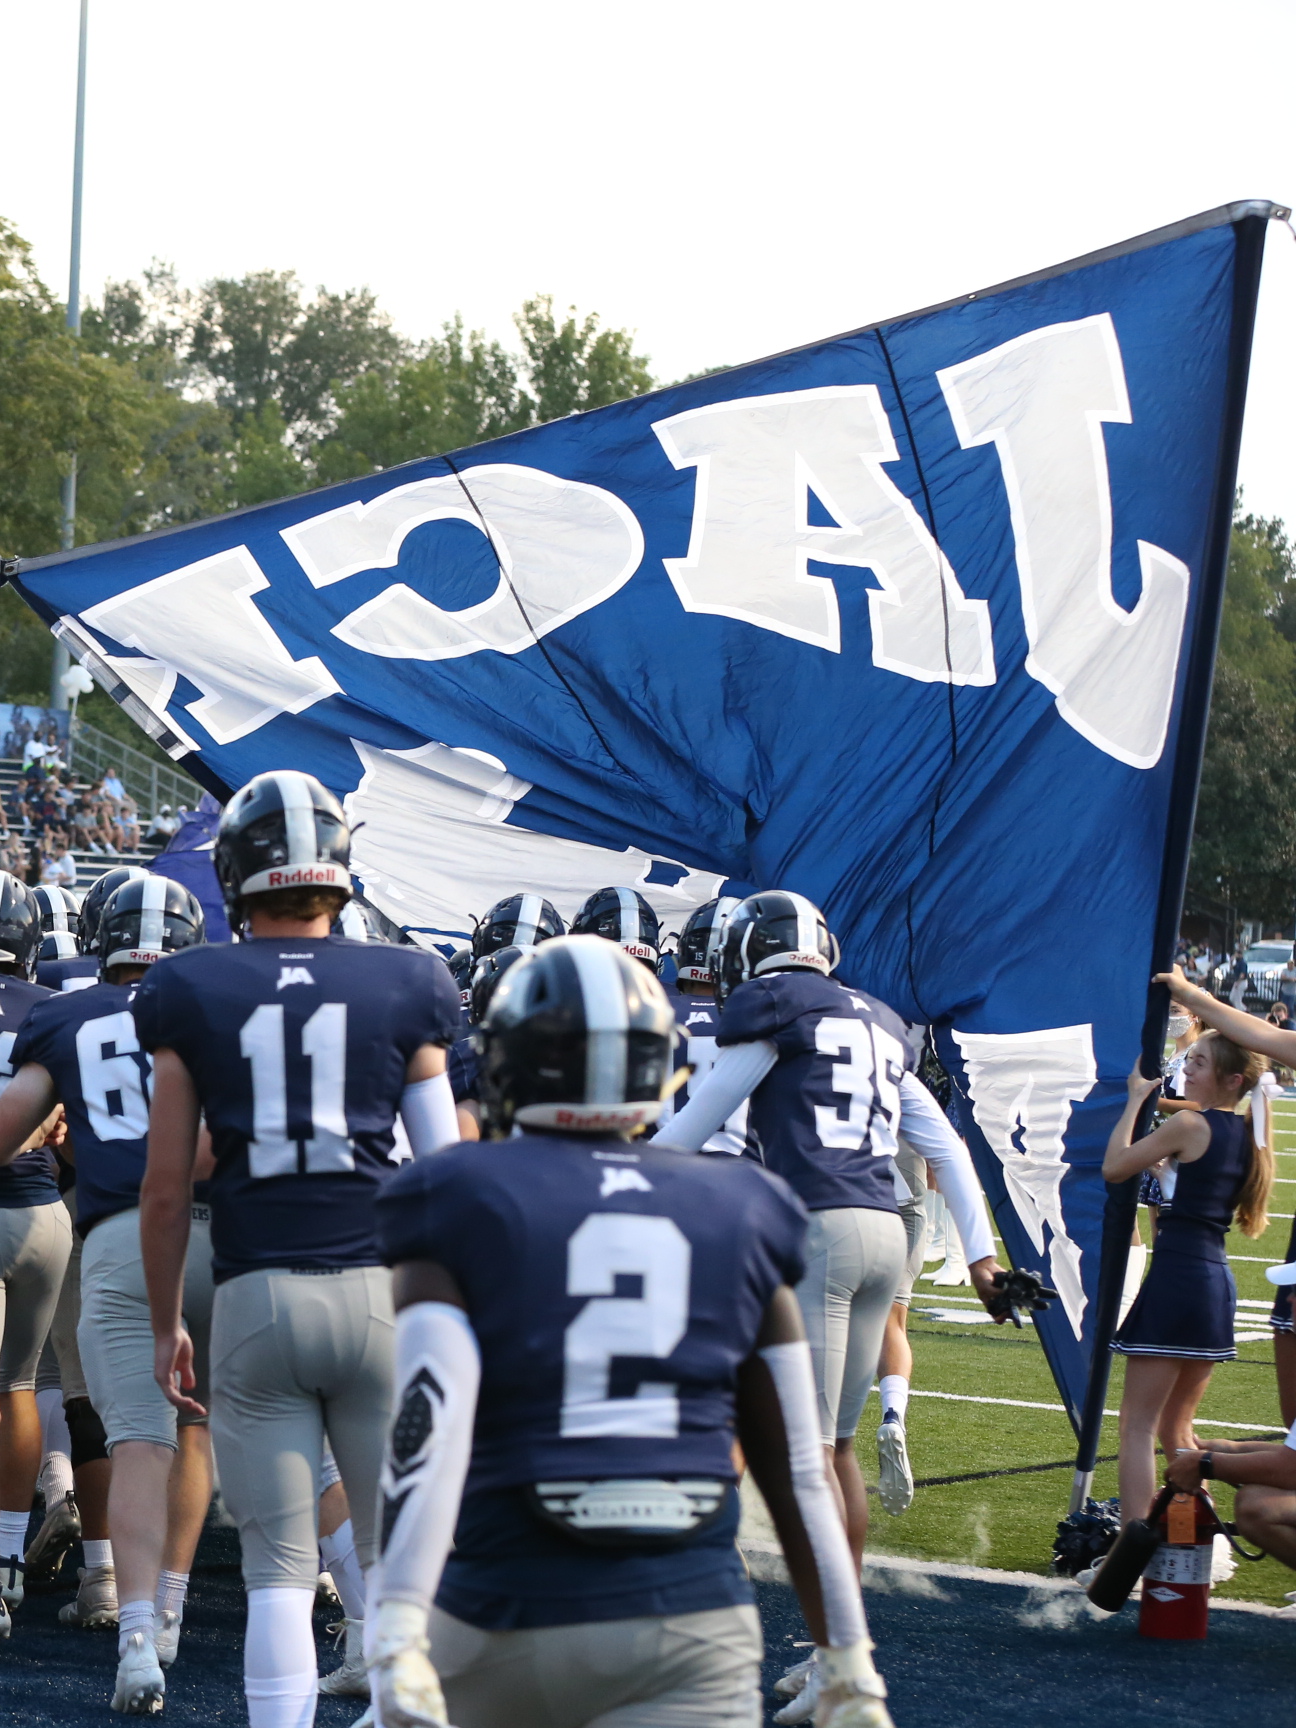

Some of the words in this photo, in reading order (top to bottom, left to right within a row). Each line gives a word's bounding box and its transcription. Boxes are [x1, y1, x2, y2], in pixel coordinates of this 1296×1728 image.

[268, 869, 336, 886] Riddell
[239, 1002, 356, 1179] 11
[560, 1212, 692, 1439] 2
